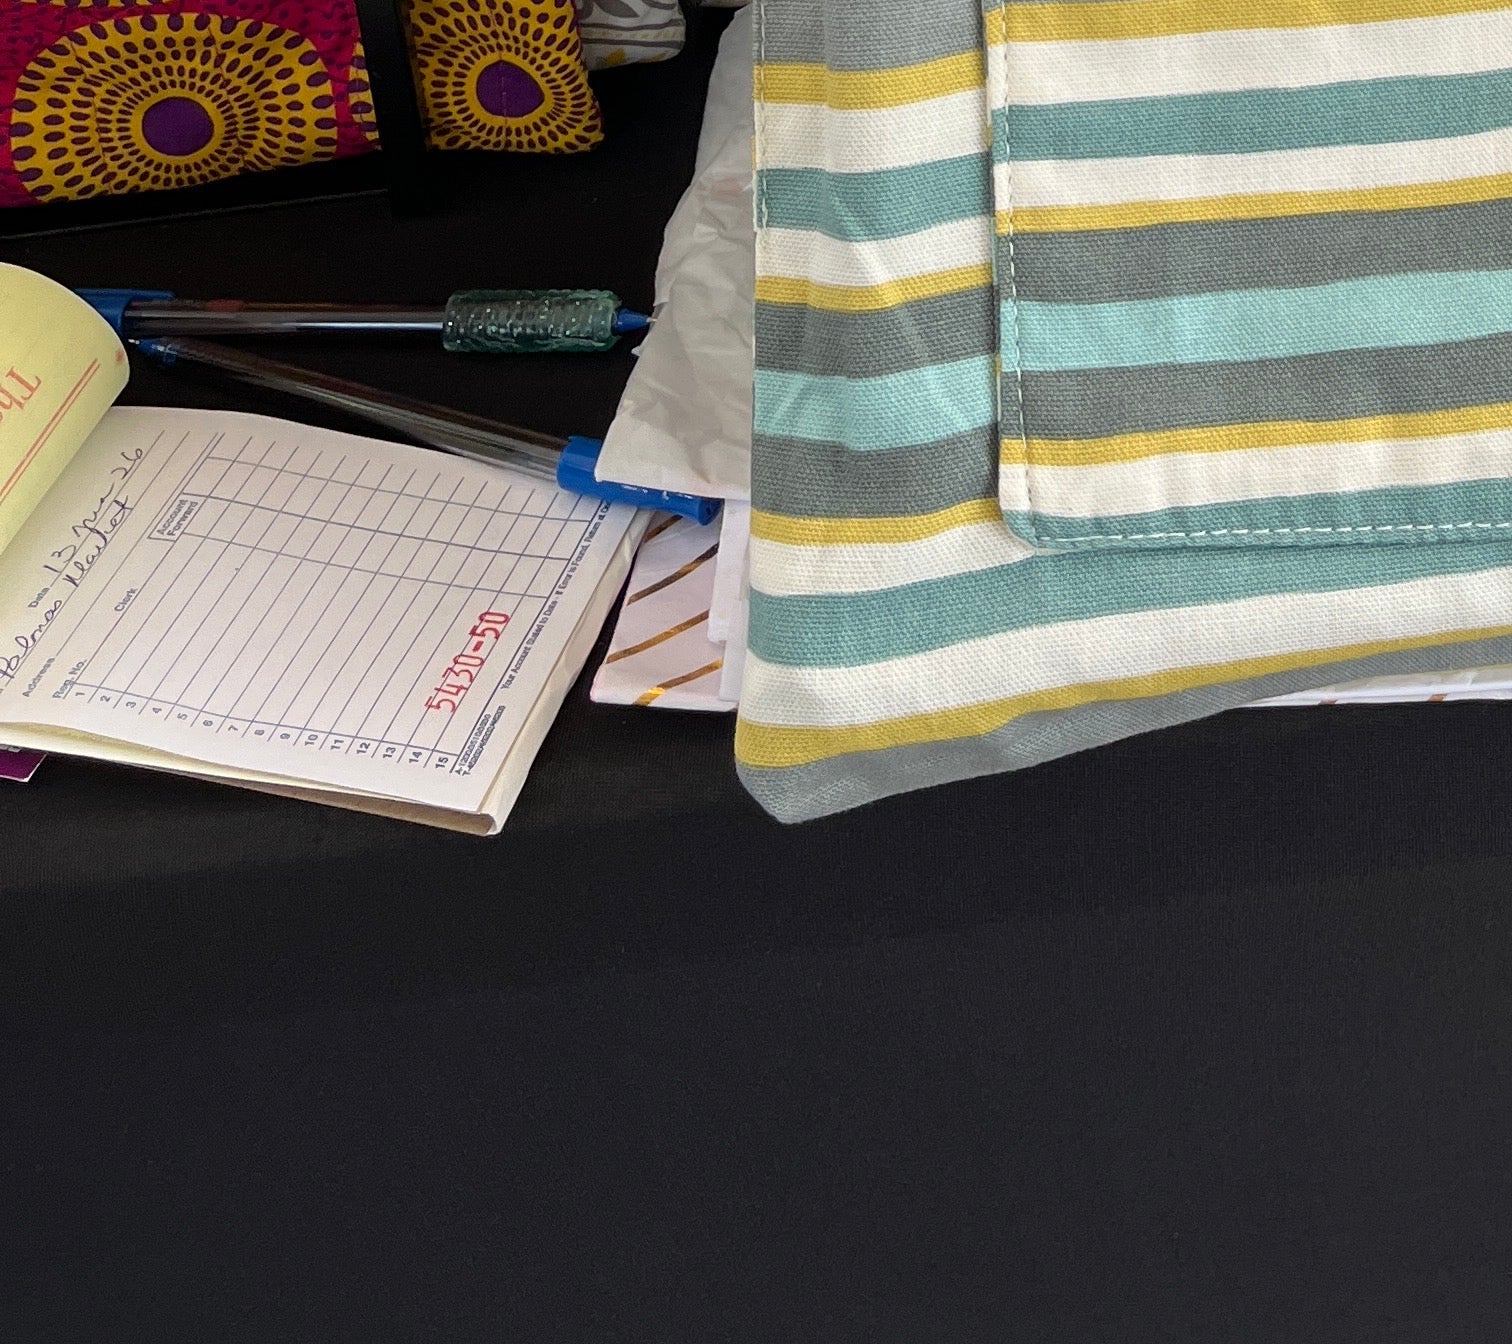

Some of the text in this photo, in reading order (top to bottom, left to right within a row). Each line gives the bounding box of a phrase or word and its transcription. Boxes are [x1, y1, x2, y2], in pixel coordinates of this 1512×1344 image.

[0, 365, 42, 423] Th
[157, 500, 188, 535] Account
[424, 611, 511, 713] 5430-50
[152, 706, 162, 714] 4
[203, 719, 213, 727] 6
[304, 734, 319, 746] 10
[330, 739, 344, 751] 11
[356, 742, 371, 754] 12
[383, 747, 396, 759] 13
[409, 751, 423, 763] 14
[435, 757, 449, 769] 15
